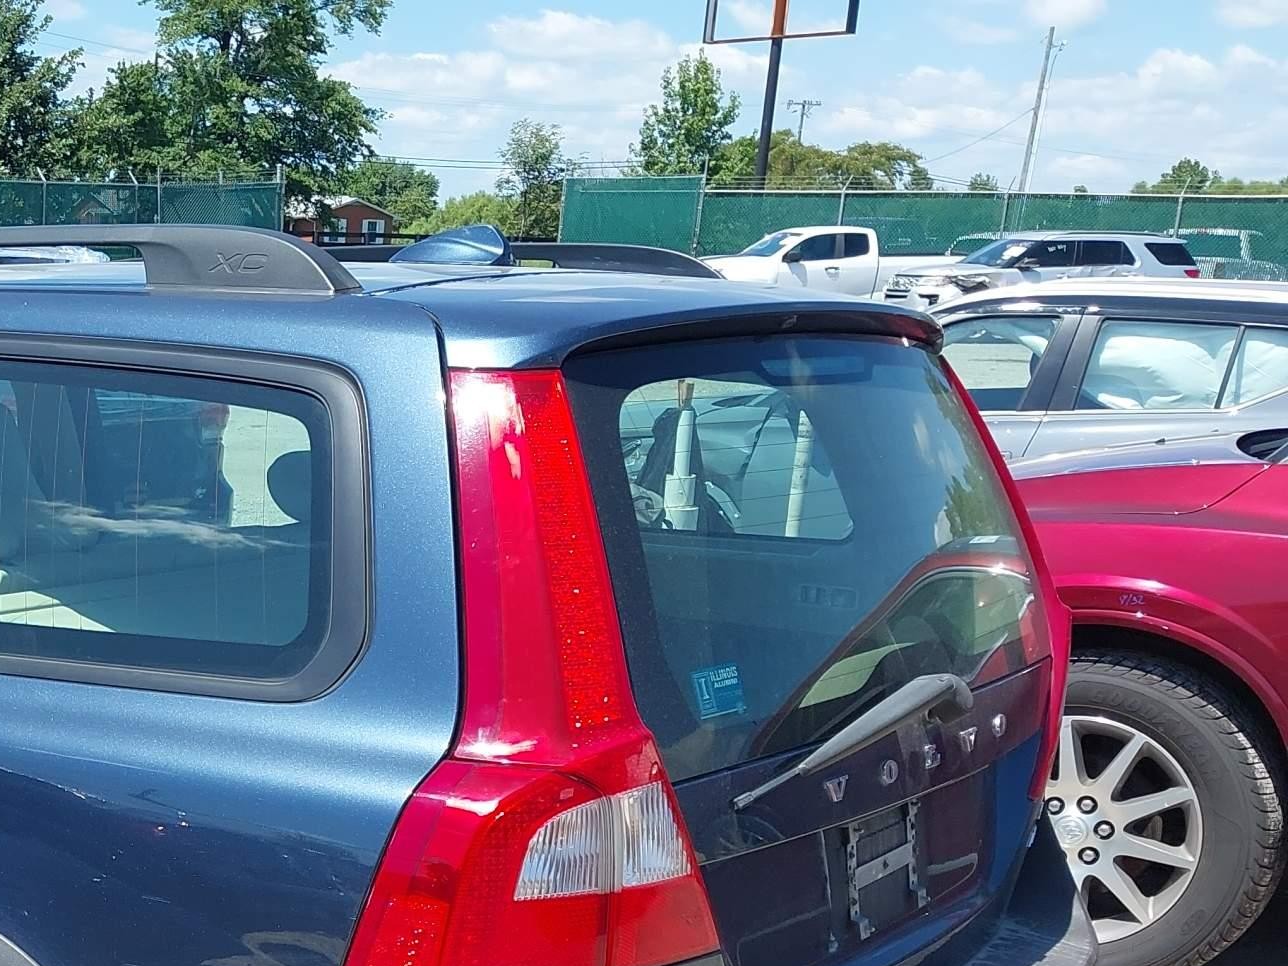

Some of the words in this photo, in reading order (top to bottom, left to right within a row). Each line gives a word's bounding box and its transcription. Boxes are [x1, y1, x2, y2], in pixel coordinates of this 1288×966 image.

[208, 251, 269, 274] XC
[709, 666, 738, 682] ILLINOIS
[823, 713, 1007, 802] VOLVO
